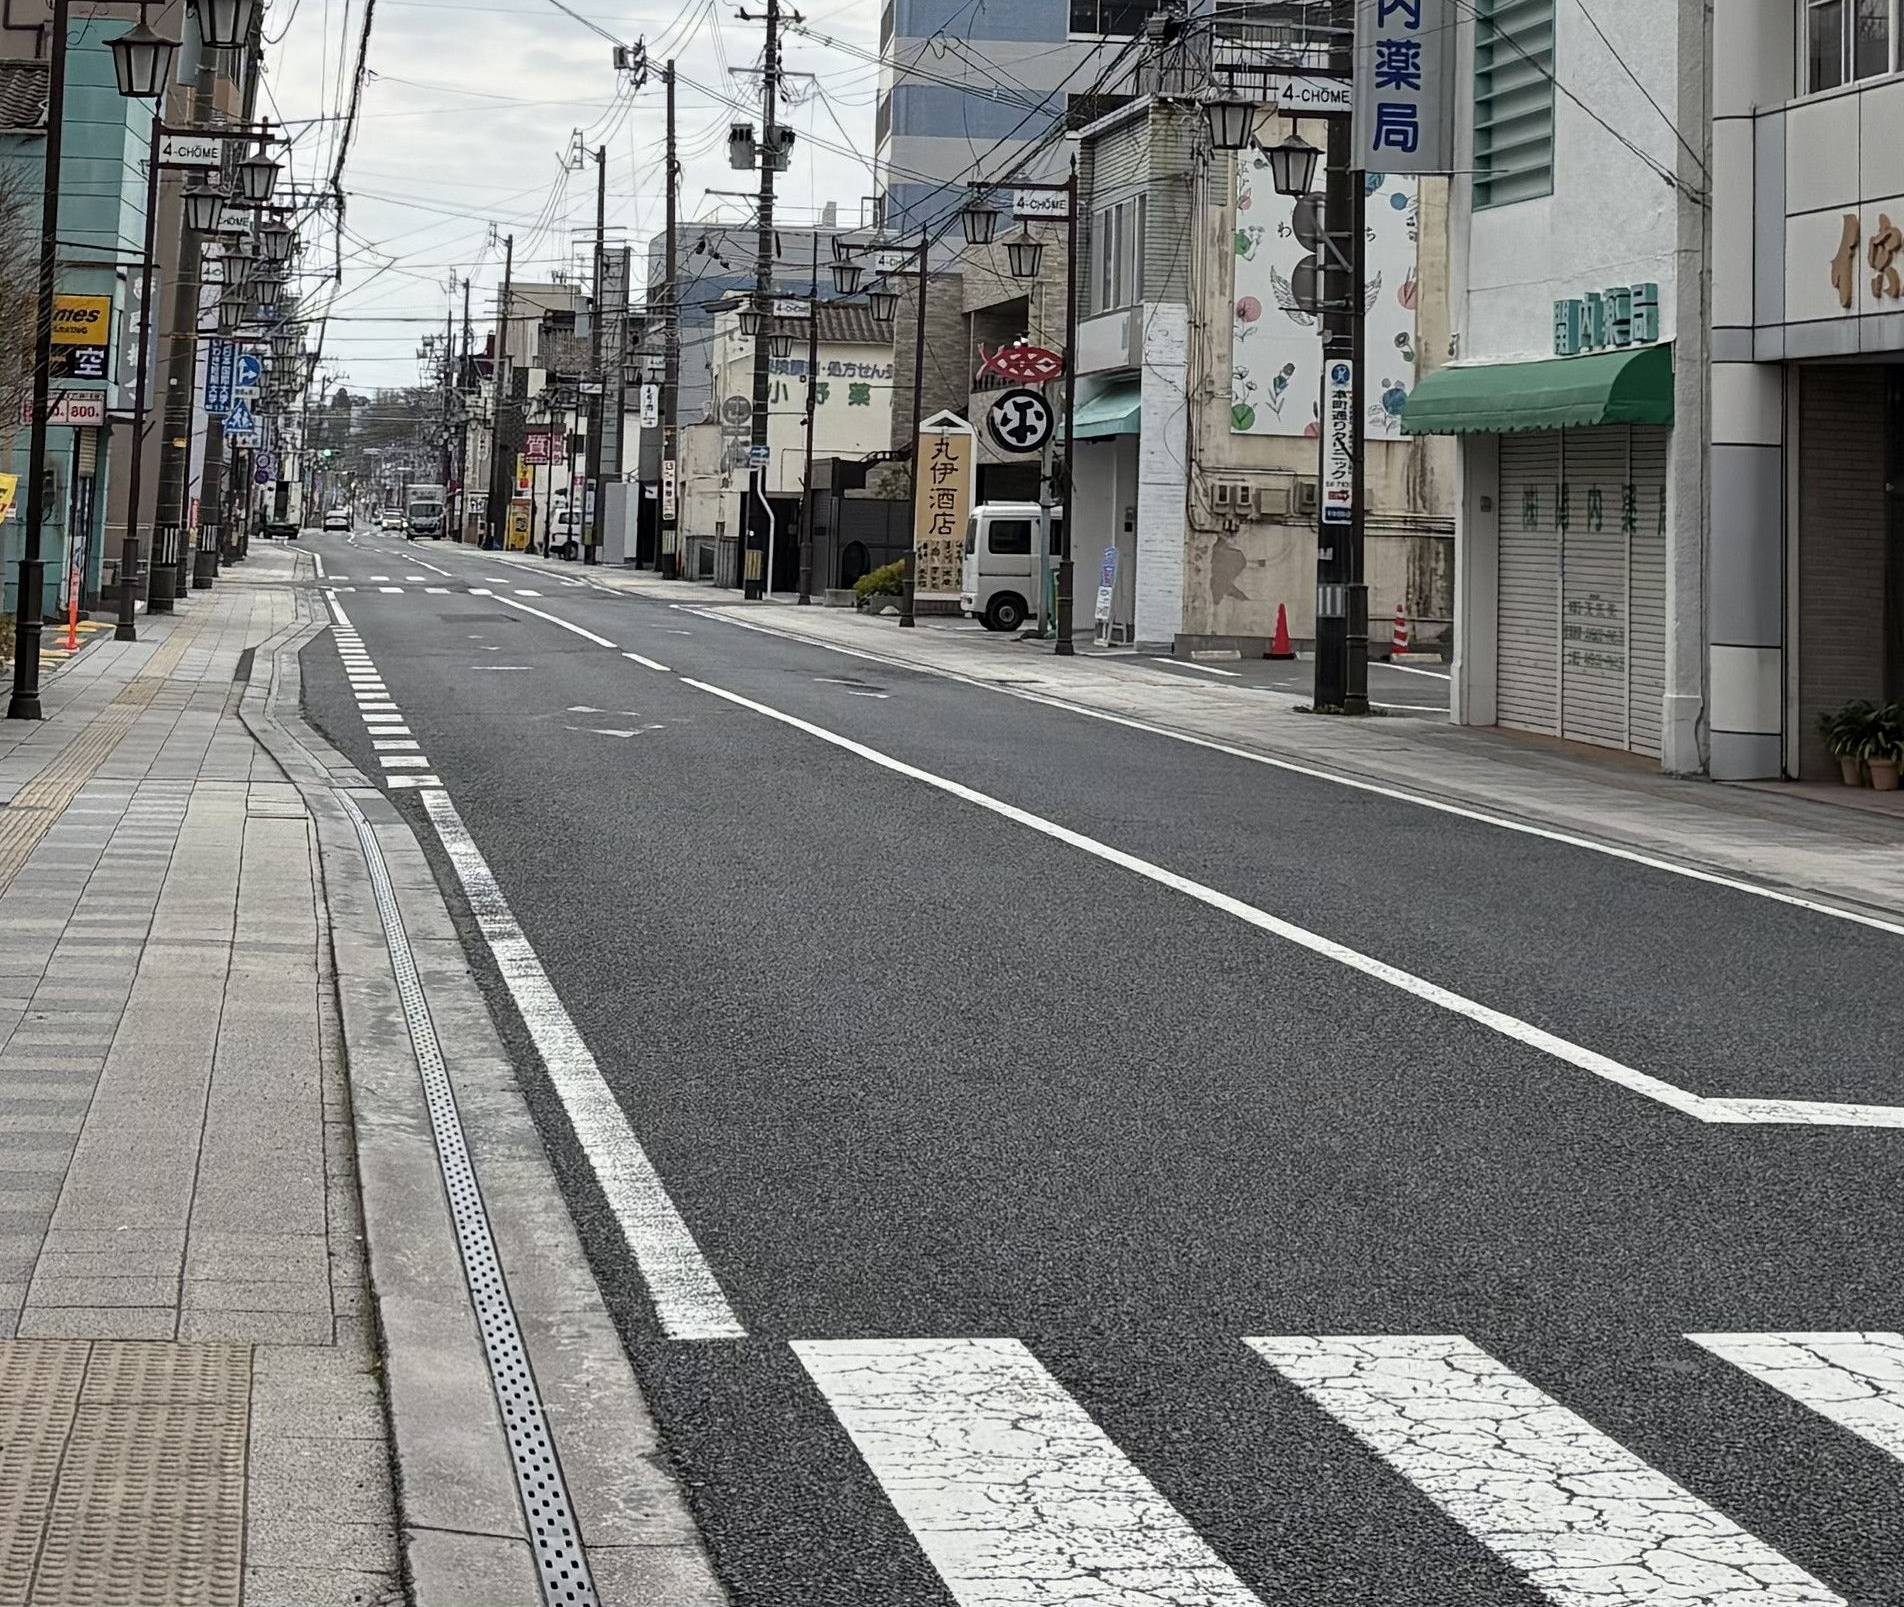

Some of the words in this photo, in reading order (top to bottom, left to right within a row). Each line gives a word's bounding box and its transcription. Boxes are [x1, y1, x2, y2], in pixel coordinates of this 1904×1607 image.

[53, 305, 100, 325] mes
[1554, 283, 1659, 355] 関内薬局
[929, 437, 959, 535] 丸伊酒店
